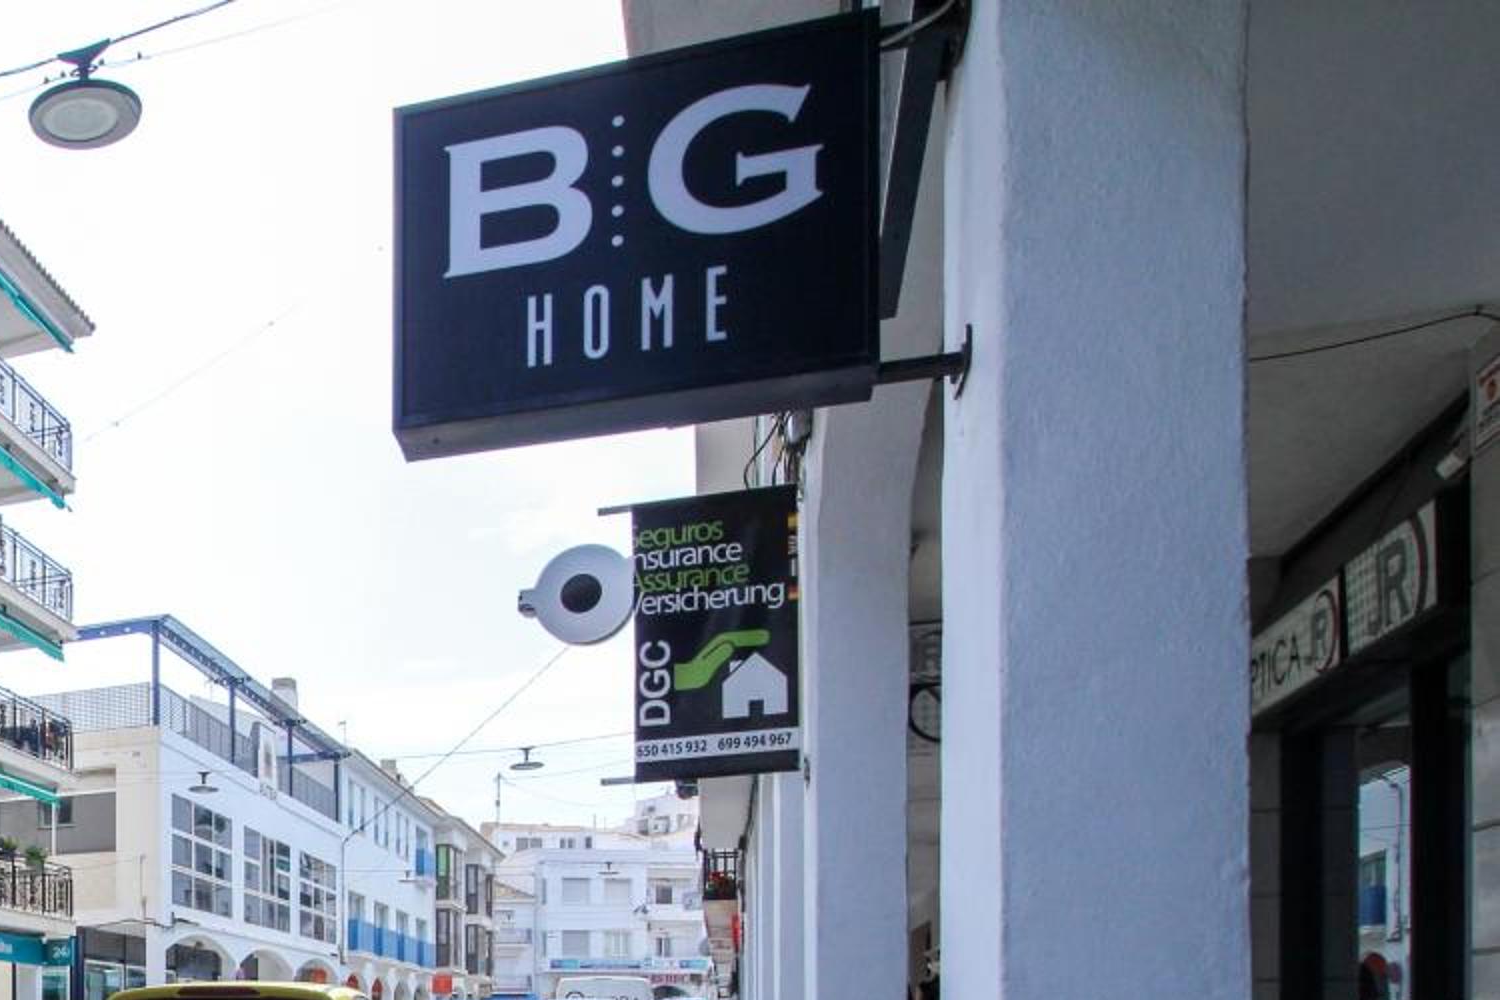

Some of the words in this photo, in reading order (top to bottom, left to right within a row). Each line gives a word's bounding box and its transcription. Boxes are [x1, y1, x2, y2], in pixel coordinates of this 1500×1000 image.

[526, 265, 728, 368] HOME
[633, 541, 743, 570] nsurance
[639, 639, 672, 727] DGC
[1250, 634, 1302, 696] PTICA
[635, 745, 660, 757] 650
[661, 743, 683, 756] 415
[685, 739, 708, 753] 932
[717, 737, 741, 751] 699
[743, 735, 766, 748] 494
[768, 732, 792, 746] 967
